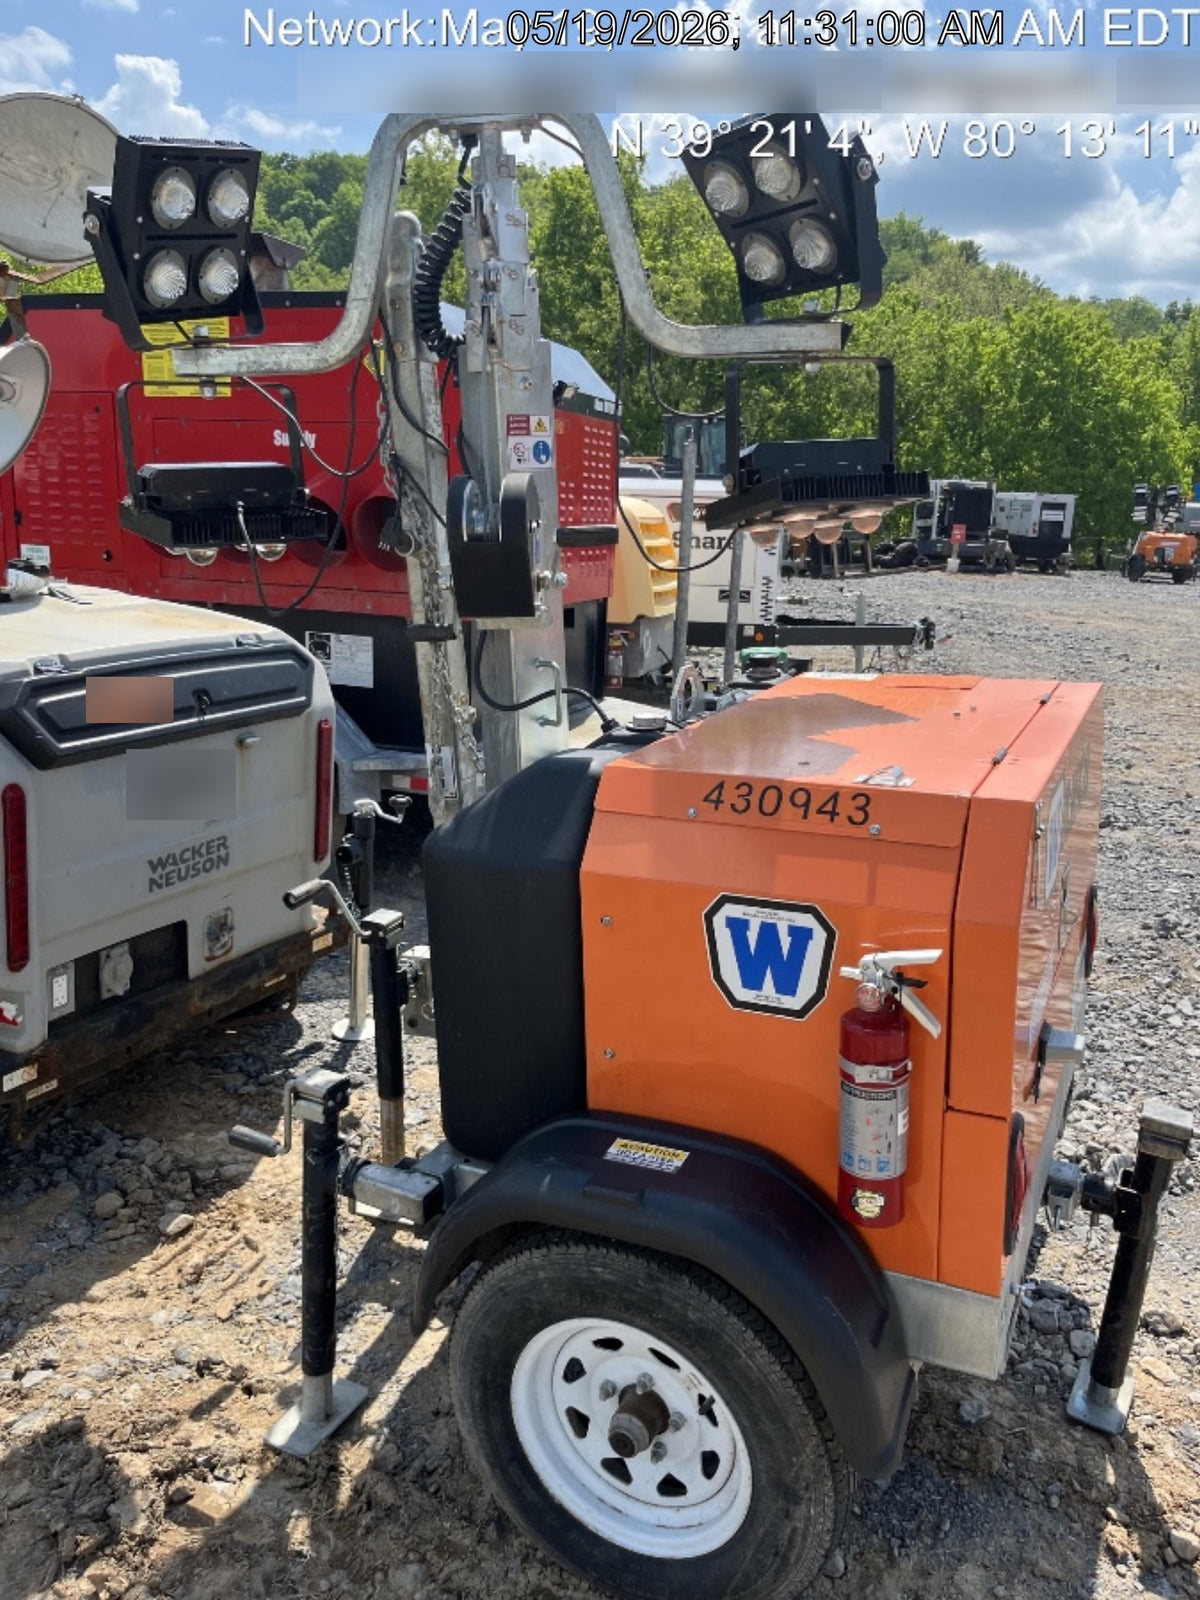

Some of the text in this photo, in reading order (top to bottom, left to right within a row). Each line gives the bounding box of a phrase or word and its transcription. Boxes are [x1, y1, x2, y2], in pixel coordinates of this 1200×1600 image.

[272, 429, 317, 449] Suly
[702, 780, 872, 826] 430943
[147, 835, 230, 875] WACKER
[148, 851, 230, 893] NEUSON
[725, 915, 813, 998] W
